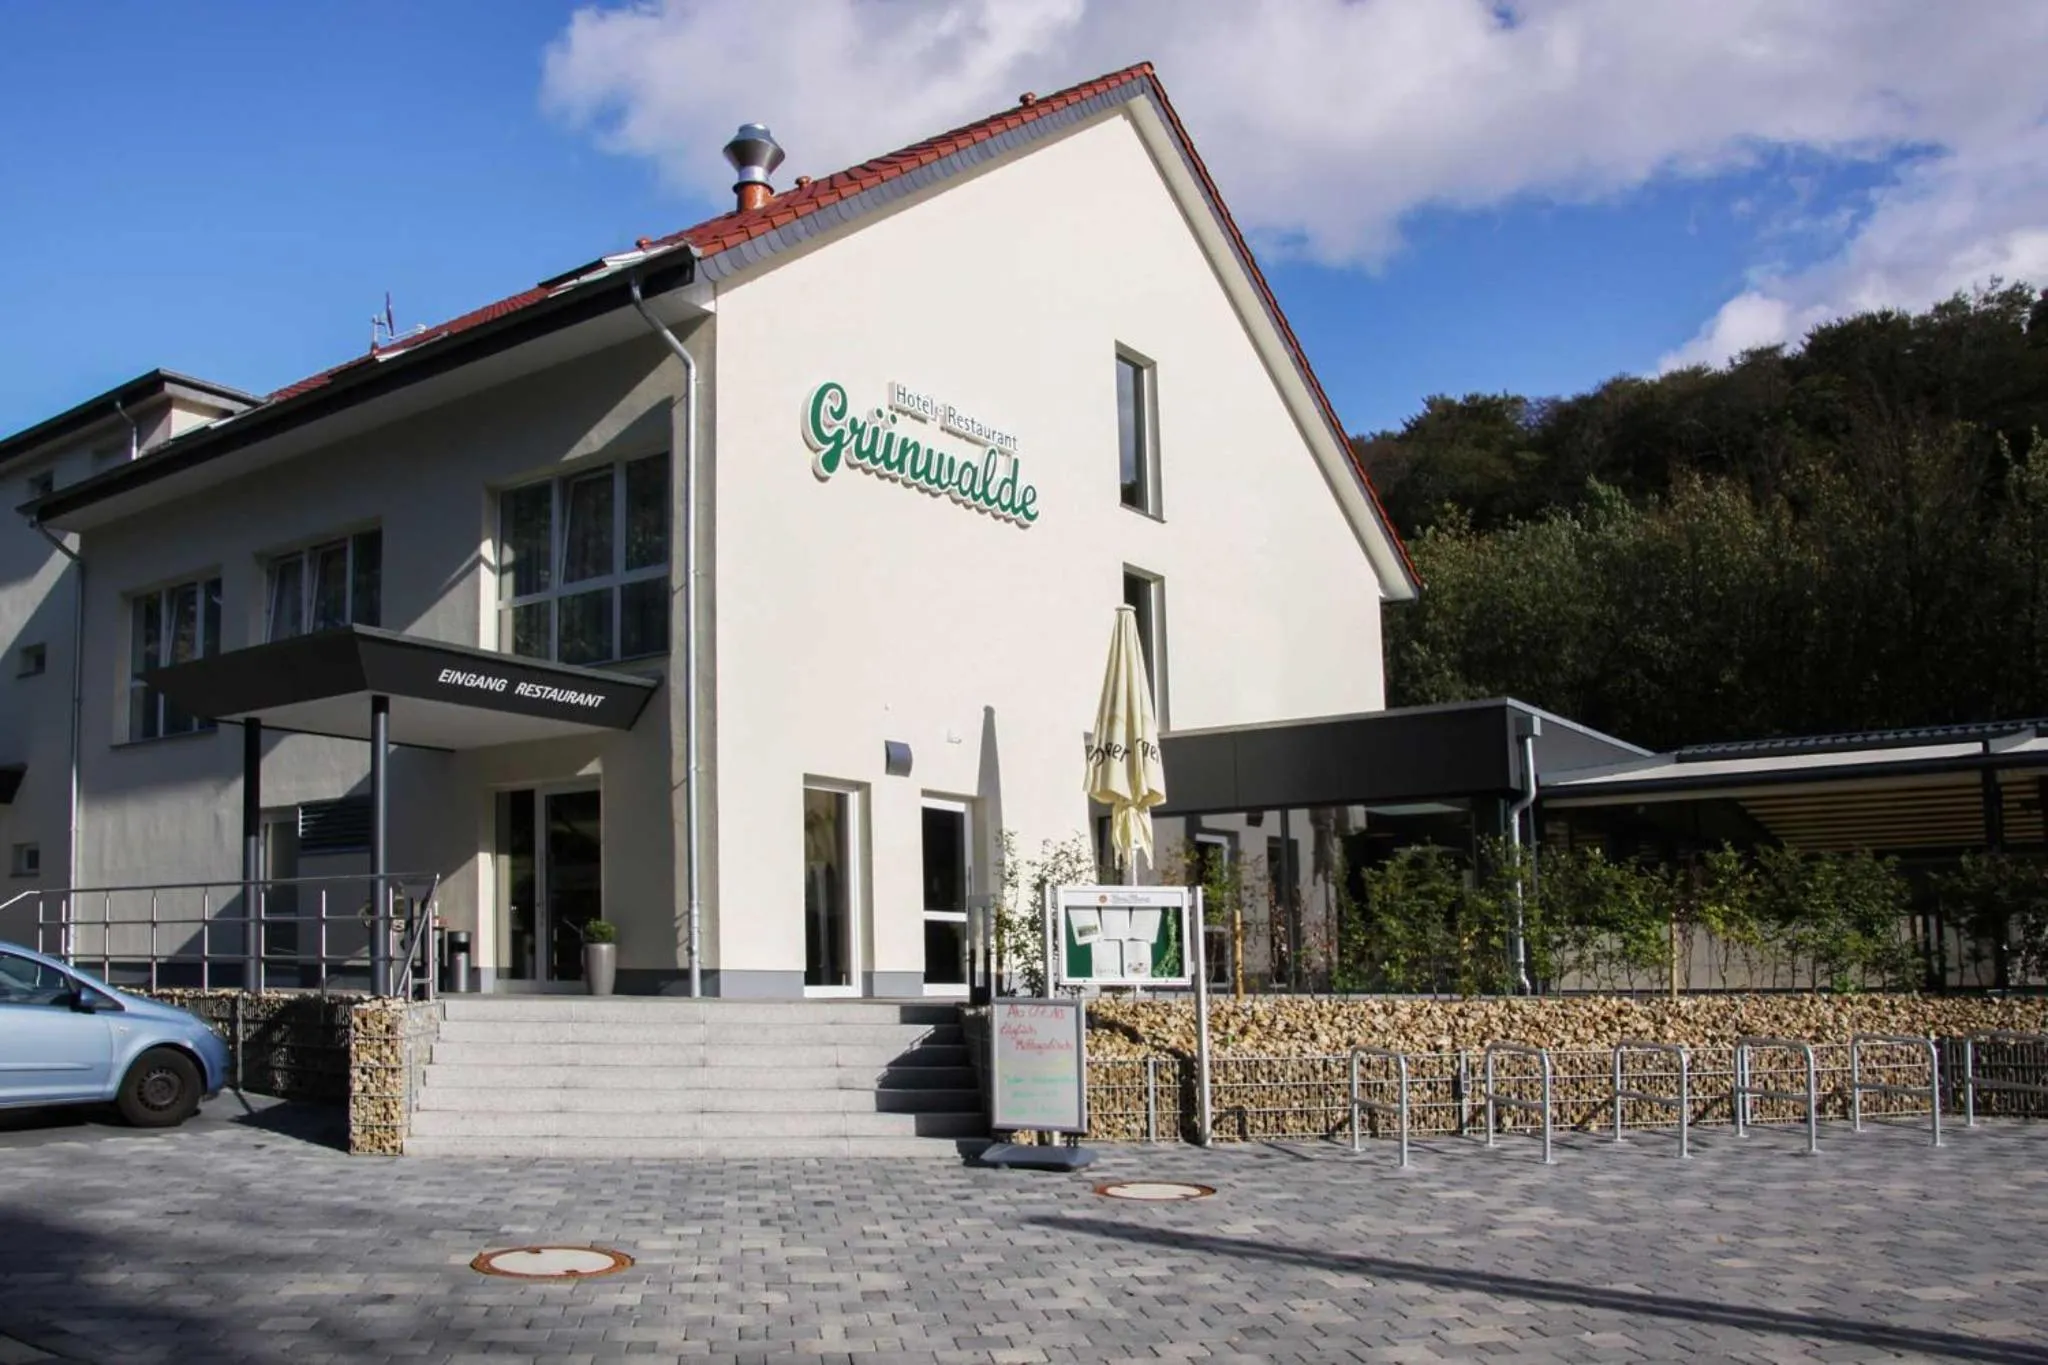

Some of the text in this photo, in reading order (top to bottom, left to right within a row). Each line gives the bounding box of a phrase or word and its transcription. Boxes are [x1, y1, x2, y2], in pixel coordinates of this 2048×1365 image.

[809, 381, 1040, 521] Grünwalde
[895, 383, 1019, 451] Hotel Restaurant
[438, 668, 606, 708] EINGANG RESTAURANT
